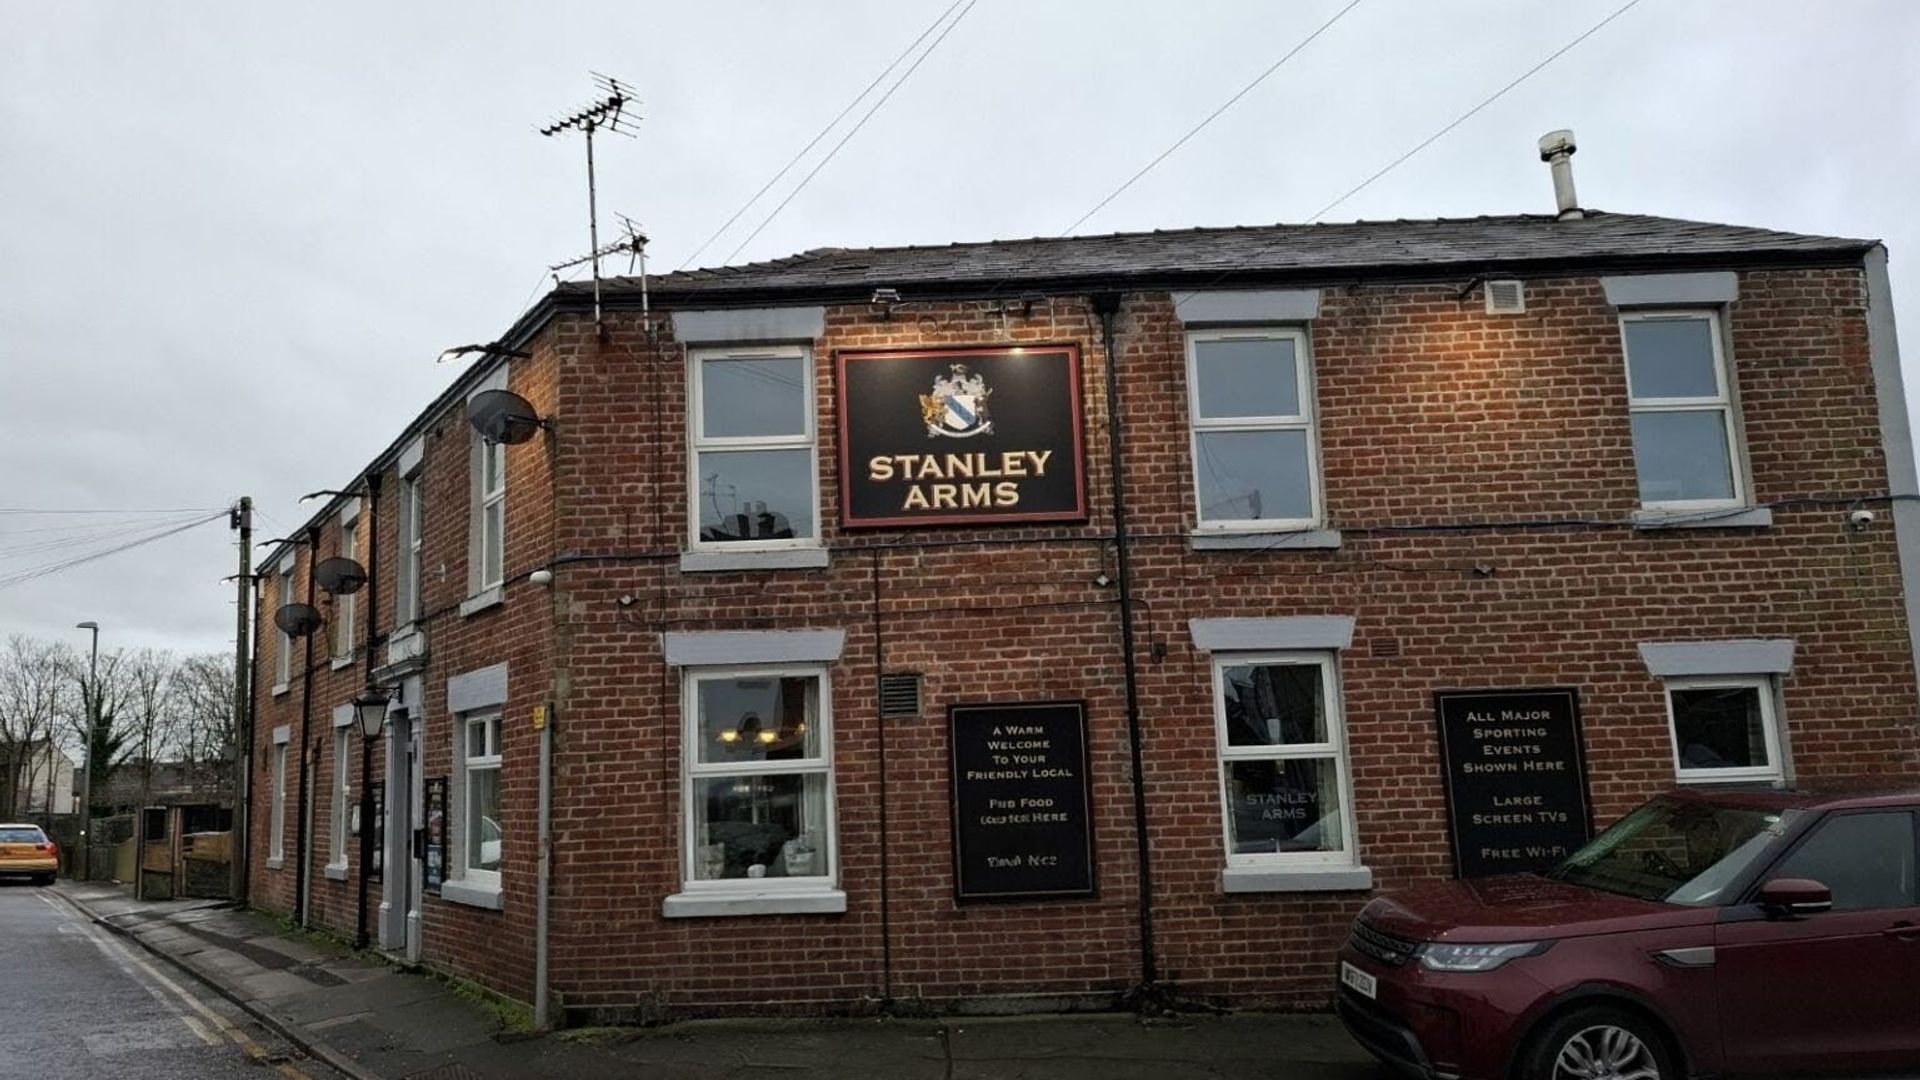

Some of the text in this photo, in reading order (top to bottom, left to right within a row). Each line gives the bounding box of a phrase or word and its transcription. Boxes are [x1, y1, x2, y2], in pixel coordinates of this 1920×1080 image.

[868, 450, 1052, 481] STANLEY
[902, 481, 1020, 509] ARMS
[1466, 710, 1551, 722] ALL MAJOR
[992, 725, 1044, 736] A WARM
[1473, 727, 1548, 739] SPORTING
[987, 740, 1051, 750] WELCOME
[1483, 745, 1542, 756] EVENTS
[992, 754, 1046, 765] TO YOUR
[1463, 760, 1566, 773] SHOWN HERE
[967, 768, 1073, 780] FRIENDLY LOCAL
[1020, 798, 1054, 808] FOOD
[1246, 792, 1318, 806] STANLEY
[1493, 795, 1543, 807] LARGE
[1033, 813, 1068, 823] HERE
[1261, 808, 1307, 820] ARMS
[1473, 813, 1533, 825] SCREEN
[1481, 846, 1567, 859] FREE WI-FI
